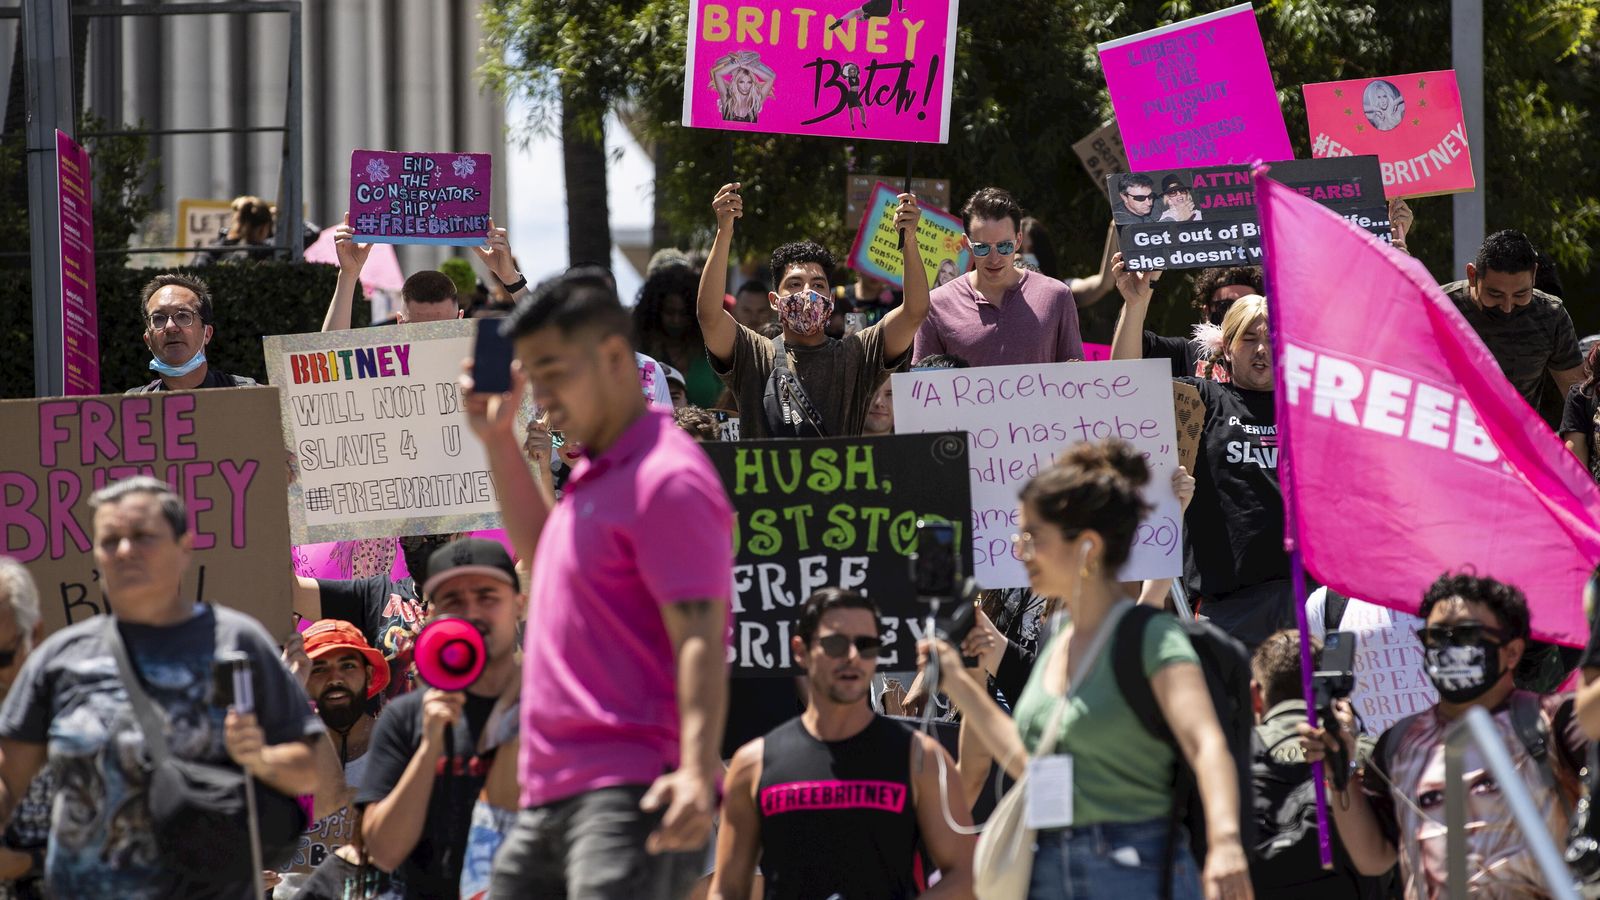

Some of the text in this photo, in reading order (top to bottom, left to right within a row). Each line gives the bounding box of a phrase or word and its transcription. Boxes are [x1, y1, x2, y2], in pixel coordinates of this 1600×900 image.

[702, 4, 925, 60] BRITNEY
[1127, 27, 1216, 67] LIBERTY
[1155, 52, 1196, 76] AND
[1158, 68, 1199, 92] THE
[1143, 80, 1229, 119] PURSUIT
[1173, 107, 1199, 126] OF
[1131, 116, 1245, 161] HAPPINESS
[404, 157, 434, 172] END
[1175, 142, 1218, 165] FOR
[400, 174, 430, 187] THE
[391, 201, 437, 218] SHIP!
[357, 213, 490, 235] #FREEBRITNEY
[1134, 231, 1171, 246] Get
[1179, 228, 1212, 242] out
[1218, 225, 1239, 240] of
[924, 258, 938, 269] the
[1128, 254, 1165, 270] she
[1170, 247, 1246, 264] doesn't
[290, 344, 411, 385] BRITNEY
[952, 372, 1139, 407] Racehorse
[291, 391, 364, 426] WILL
[372, 384, 426, 419] NOT
[38, 394, 198, 467] FREE
[1008, 422, 1067, 444] has
[299, 425, 461, 471] SLAVE 4 U
[734, 445, 893, 495] HUSH,
[0, 459, 260, 564] BREY
[730, 555, 870, 613] FREE
[765, 784, 902, 811] #FREEBRITNEY
